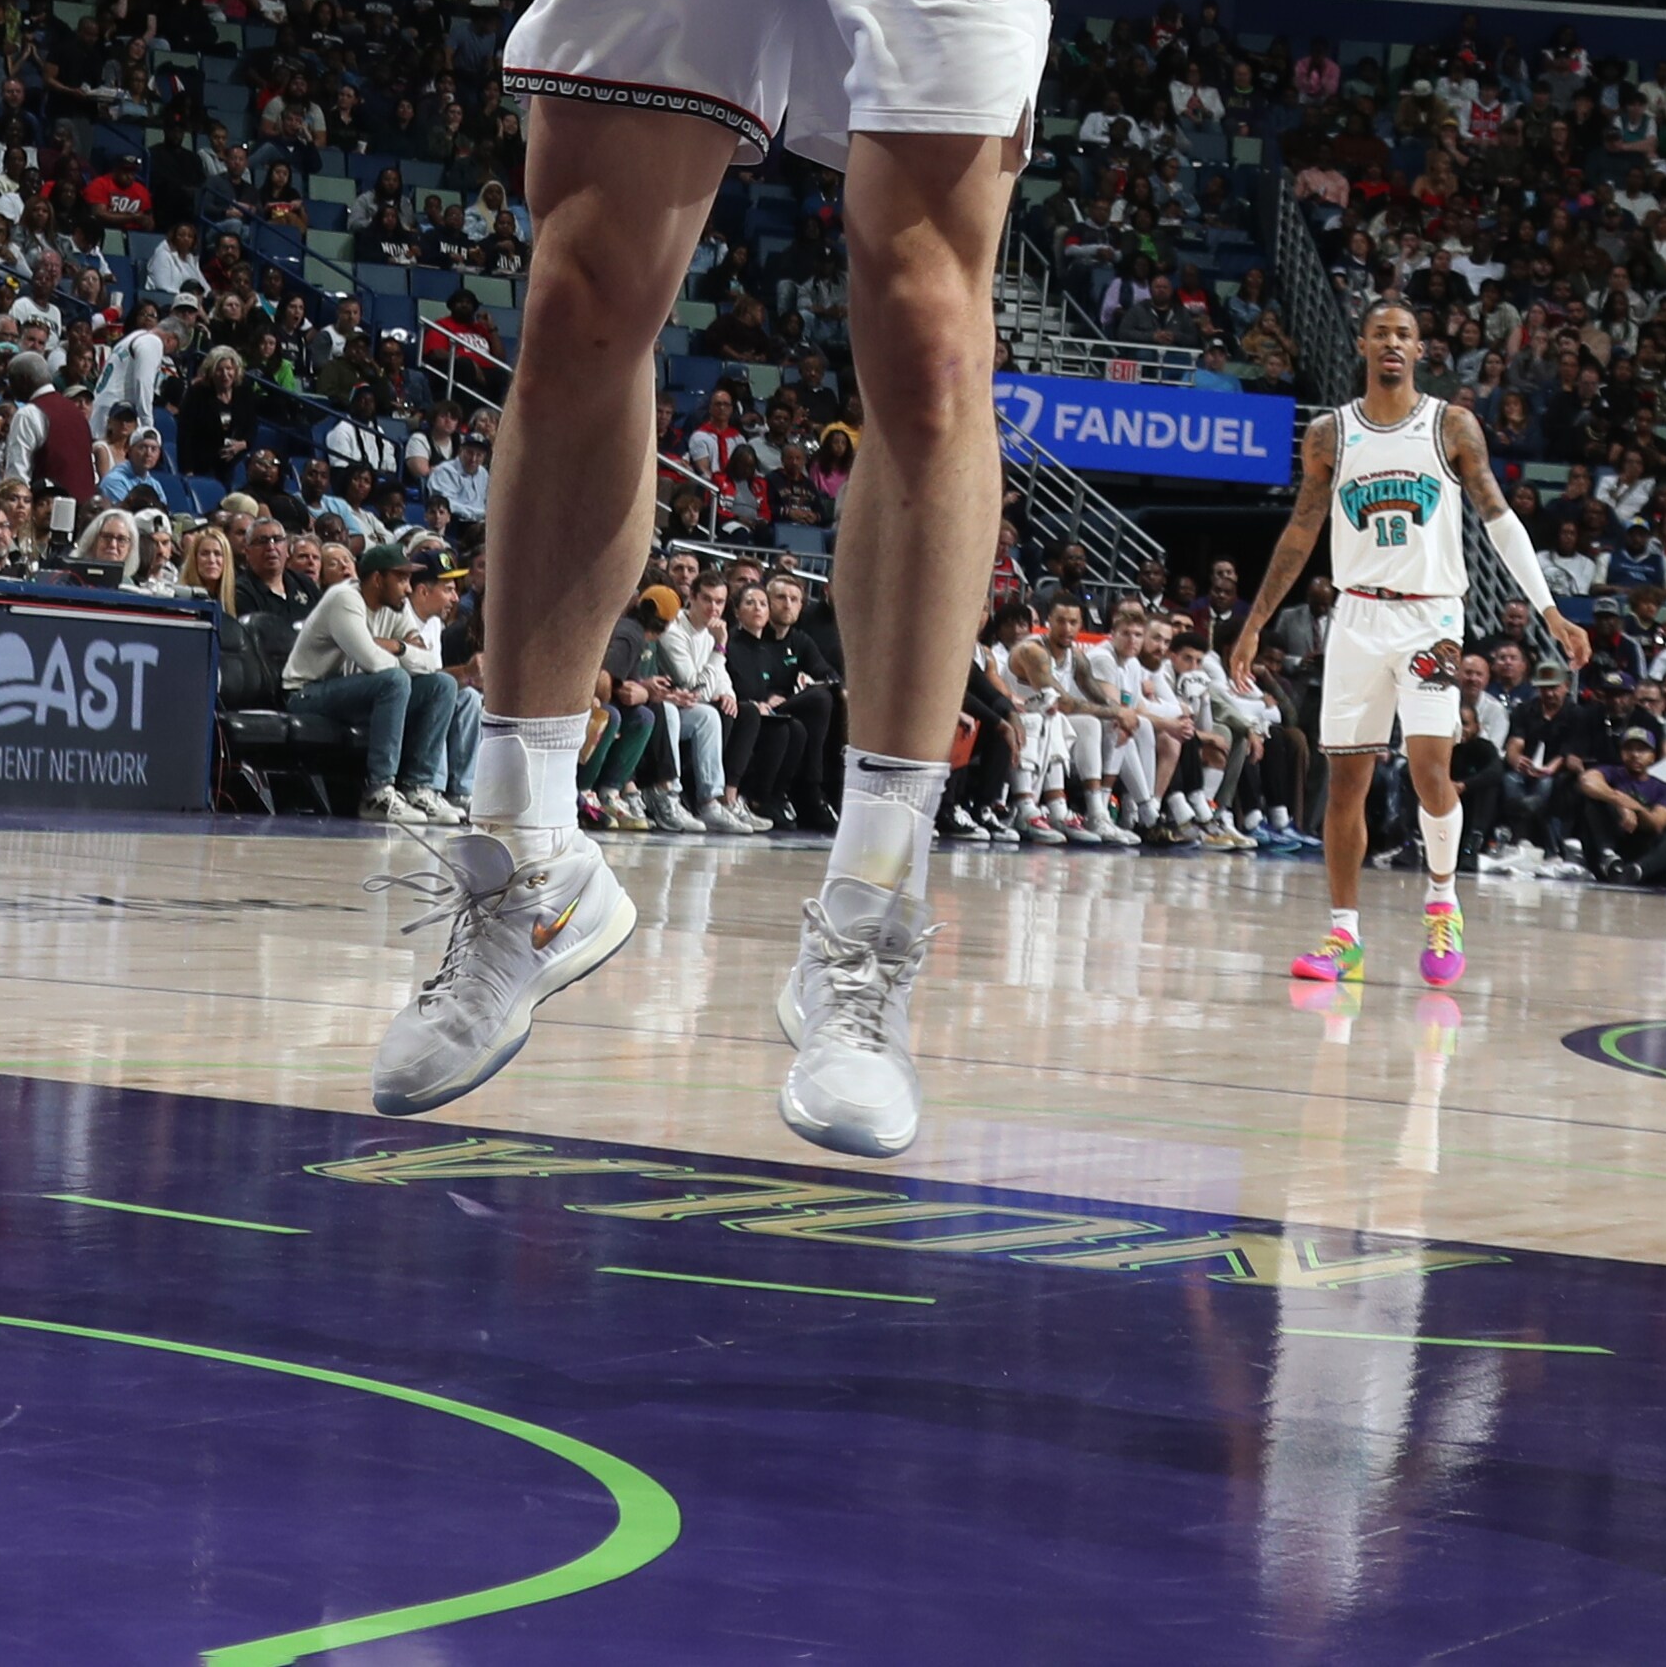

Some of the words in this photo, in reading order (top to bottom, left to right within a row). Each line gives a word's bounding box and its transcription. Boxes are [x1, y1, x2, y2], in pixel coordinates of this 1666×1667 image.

[1112, 362, 1137, 383] EXIT
[1053, 402, 1268, 458] FANDUEL
[1339, 472, 1442, 534] GRIZZLIES
[1375, 515, 1408, 547] 12
[48, 748, 149, 787] NETWORK
